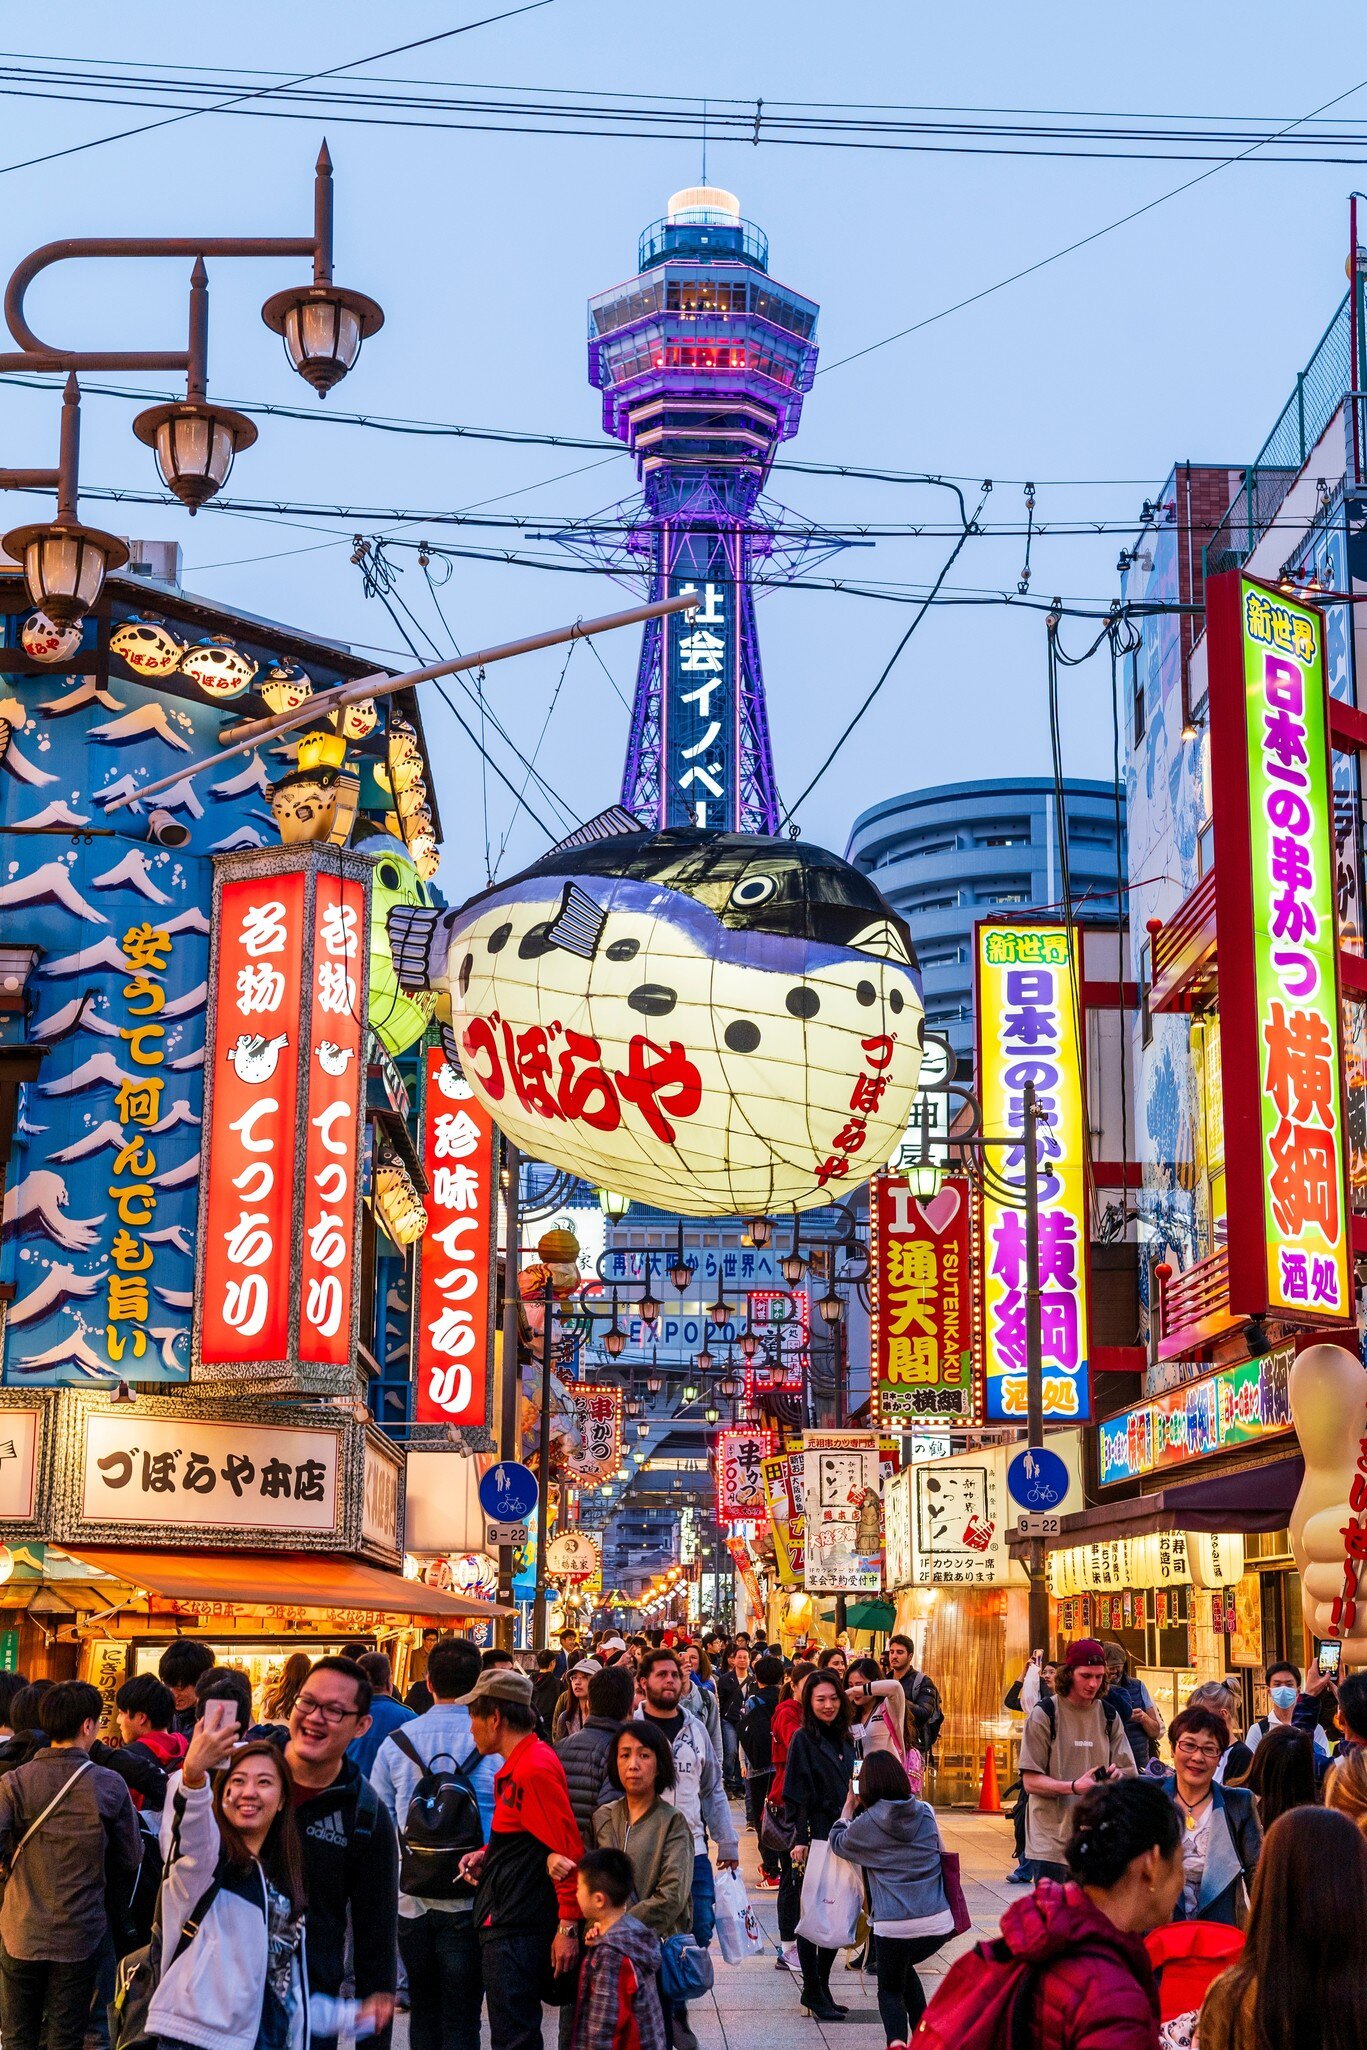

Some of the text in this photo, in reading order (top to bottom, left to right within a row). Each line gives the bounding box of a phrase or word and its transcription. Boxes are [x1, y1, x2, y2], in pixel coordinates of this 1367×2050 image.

[1247, 593, 1317, 663] 新世界
[986, 932, 1070, 966] 新世界
[462, 1010, 701, 1143] づぼらや
[814, 1032, 897, 1186] づぼらや
[106, 922, 172, 1361] 安うて何んでも旨い
[222, 1097, 280, 1337] てっちり
[305, 1100, 354, 1338] てっちり
[427, 1109, 481, 1414] 珍味てっちり
[613, 1252, 785, 1278] 再び大阪から世界へ
[1280, 1251, 1340, 1306] 酒処
[886, 1239, 939, 1385] 通天閣
[942, 1240, 961, 1383] TSUTENKAKU
[882, 1392, 912, 1400] 日本一の
[883, 1401, 912, 1411] 串かつ
[912, 1388, 963, 1413] 横綱
[1005, 1378, 1077, 1414] 酒処
[589, 1396, 614, 1460] 串かつ
[808, 1438, 875, 1448] 元祖串カツ専門店
[97, 1447, 327, 1501] づぼらや本店
[933, 1558, 995, 1568] カウンター席
[933, 1571, 996, 1581] 座敷あります
[1160, 1538, 1170, 1578] お造り
[1172, 1539, 1186, 1574] 寿司
[808, 1575, 878, 1586] 宴会予約受付中
[306, 1826, 348, 1847] adidas
